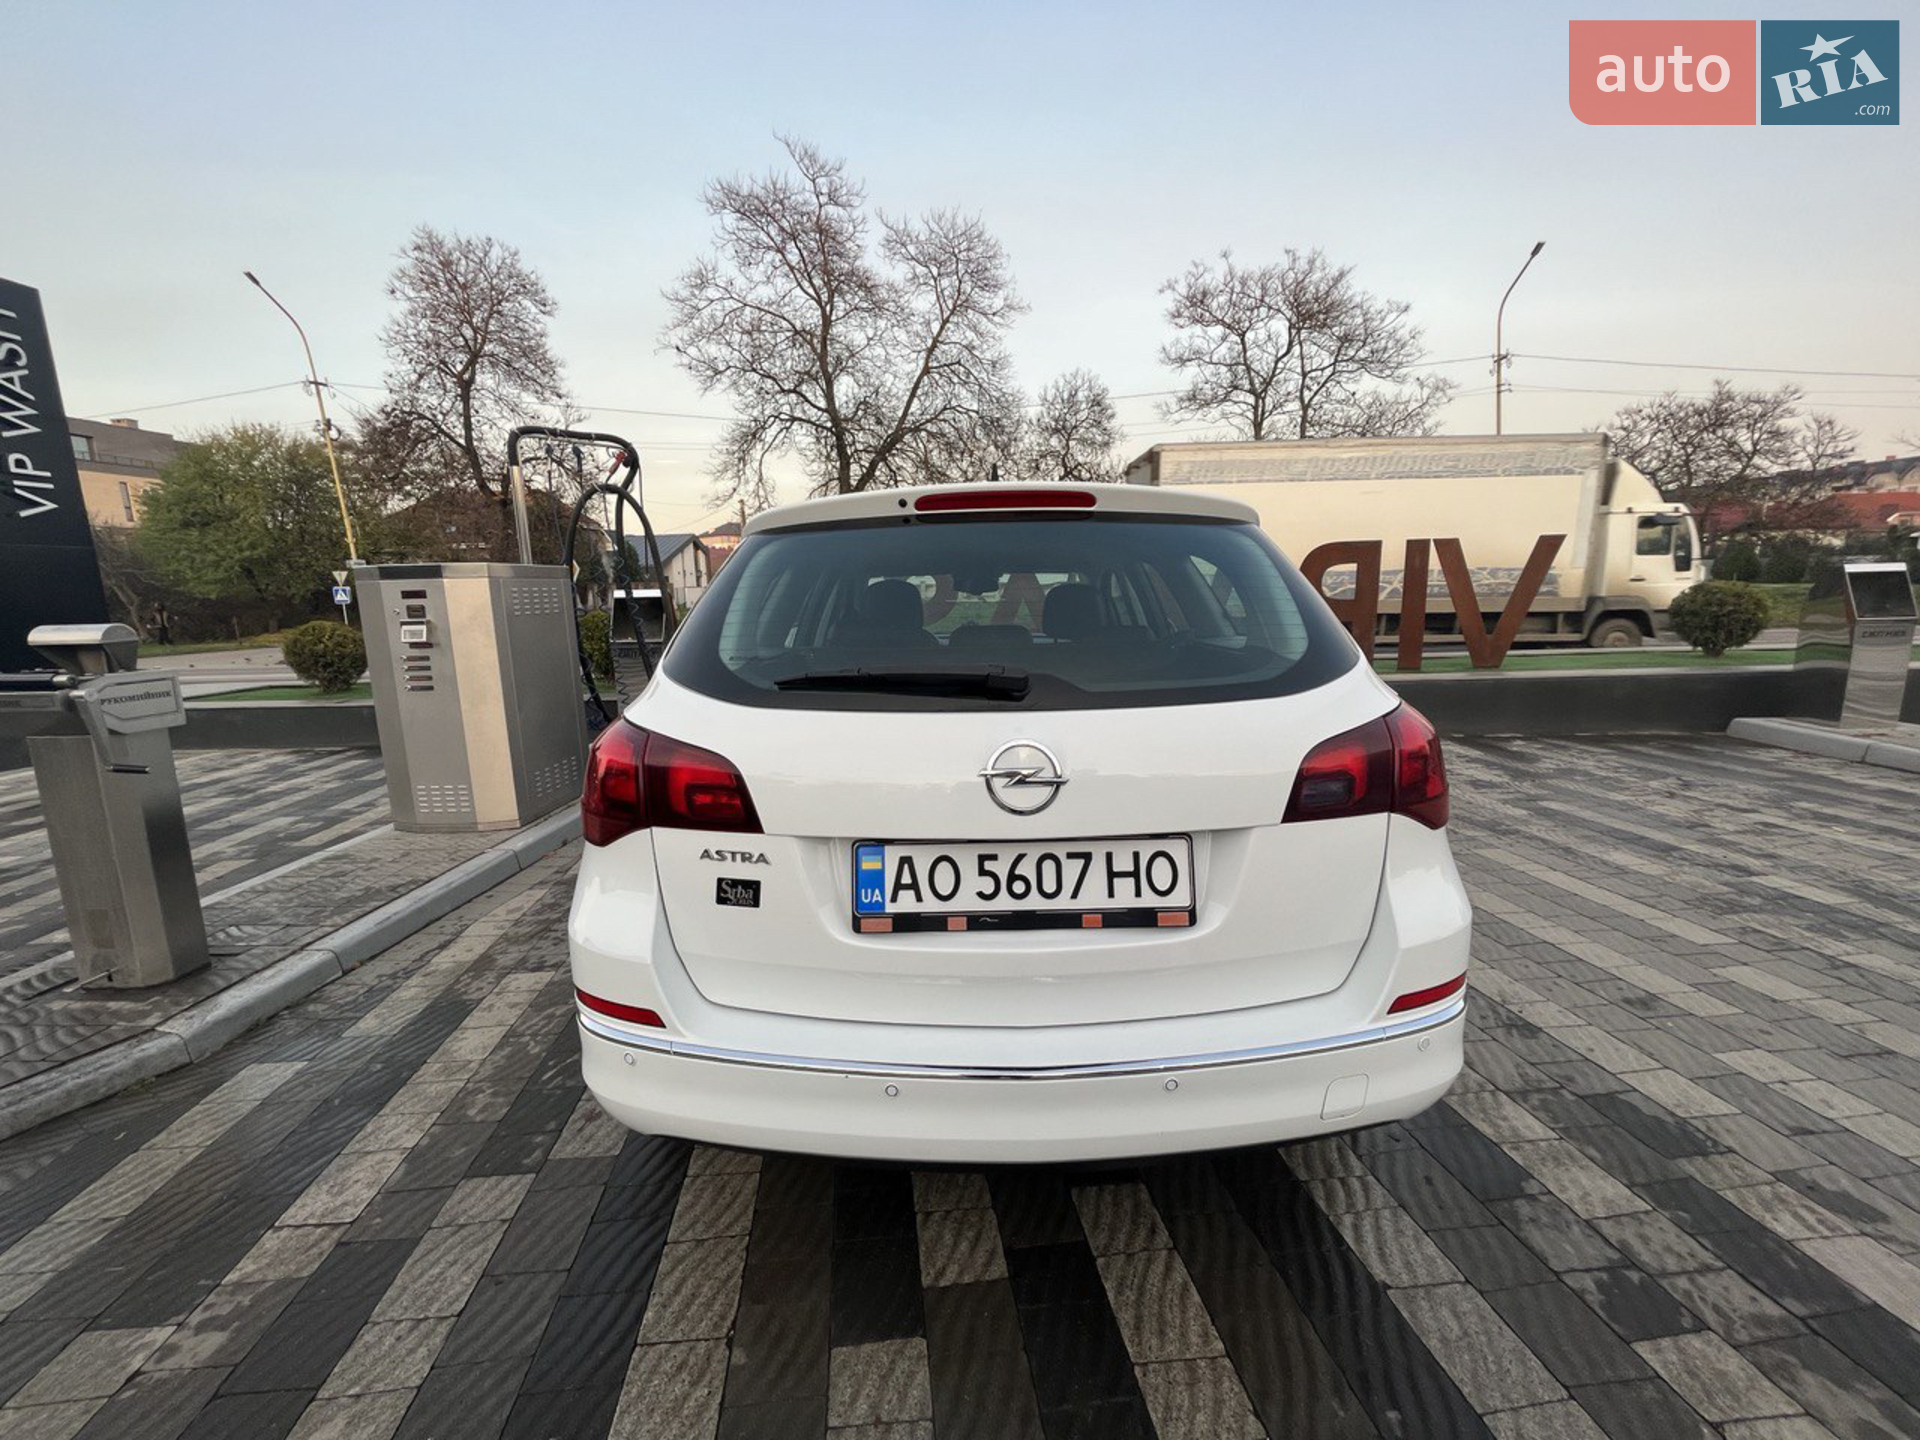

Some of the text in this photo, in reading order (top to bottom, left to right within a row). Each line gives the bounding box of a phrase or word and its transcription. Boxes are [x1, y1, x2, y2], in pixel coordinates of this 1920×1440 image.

[8, 452, 59, 518] VIP
[699, 848, 772, 865] ASTRA
[889, 850, 1179, 903] AO 5607 HO
[861, 889, 882, 903] UA
